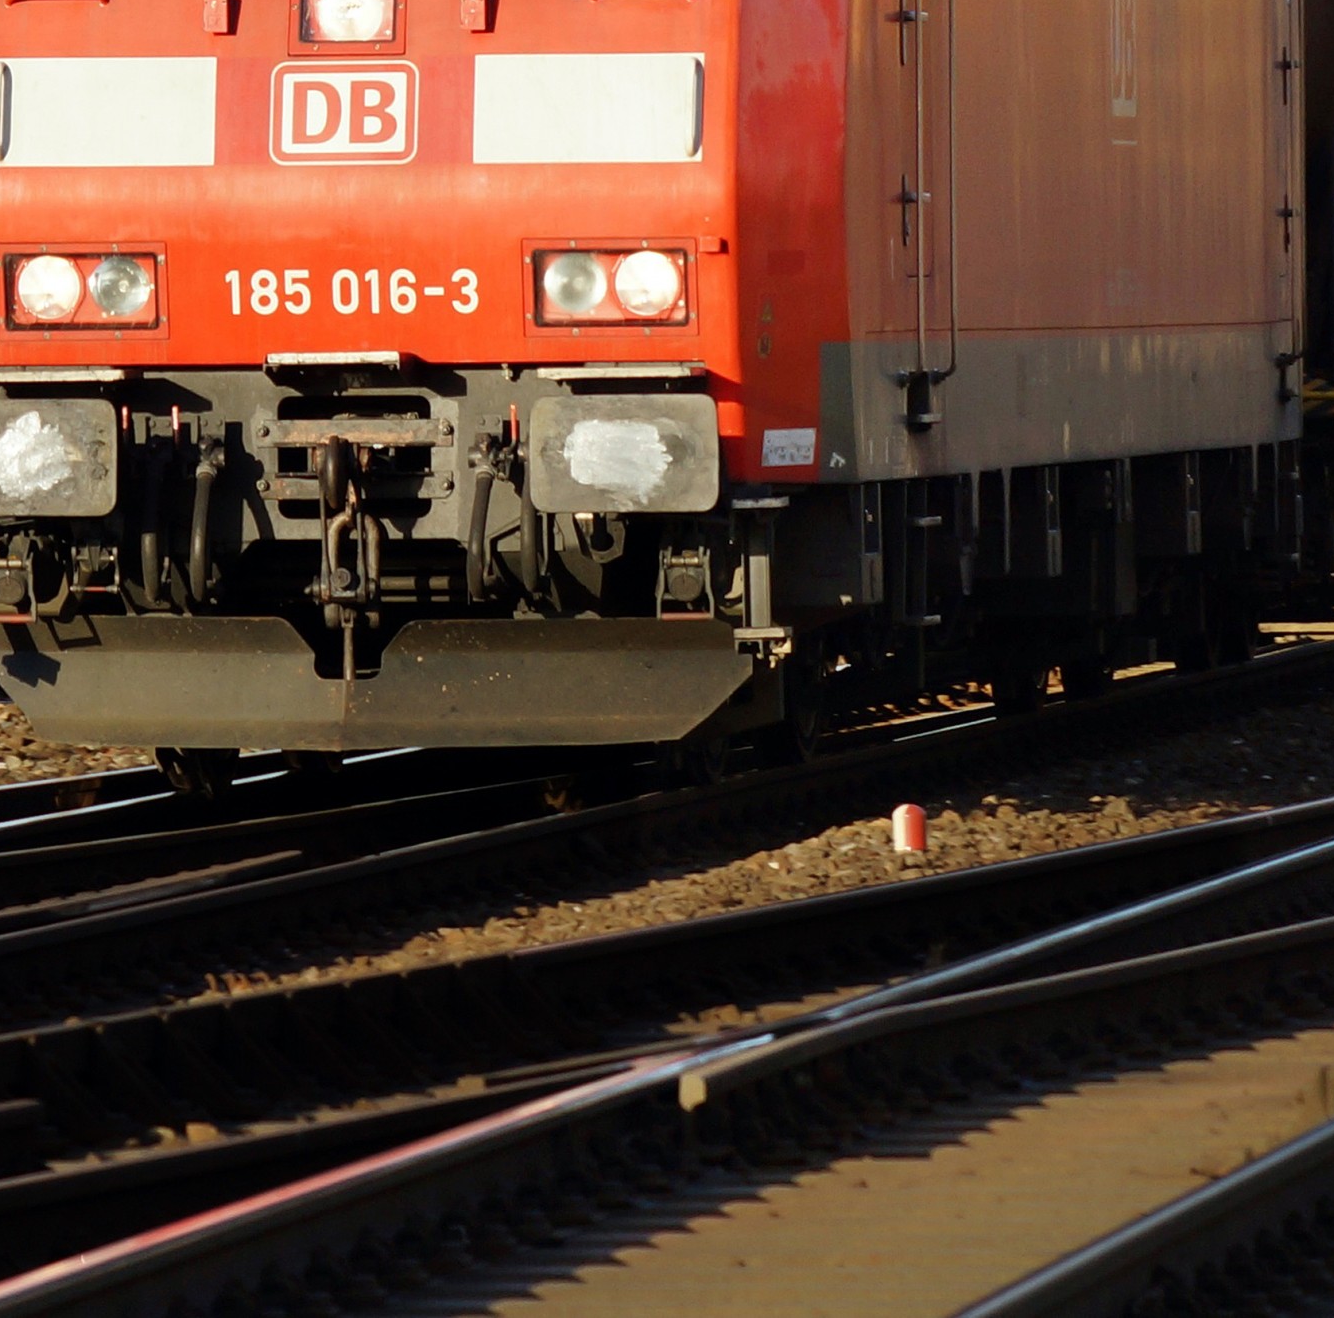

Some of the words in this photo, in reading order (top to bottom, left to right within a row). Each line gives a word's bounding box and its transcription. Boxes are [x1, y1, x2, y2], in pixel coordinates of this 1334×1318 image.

[291, 80, 398, 145] DB
[224, 268, 312, 316] 185
[330, 267, 480, 315] 016-3
